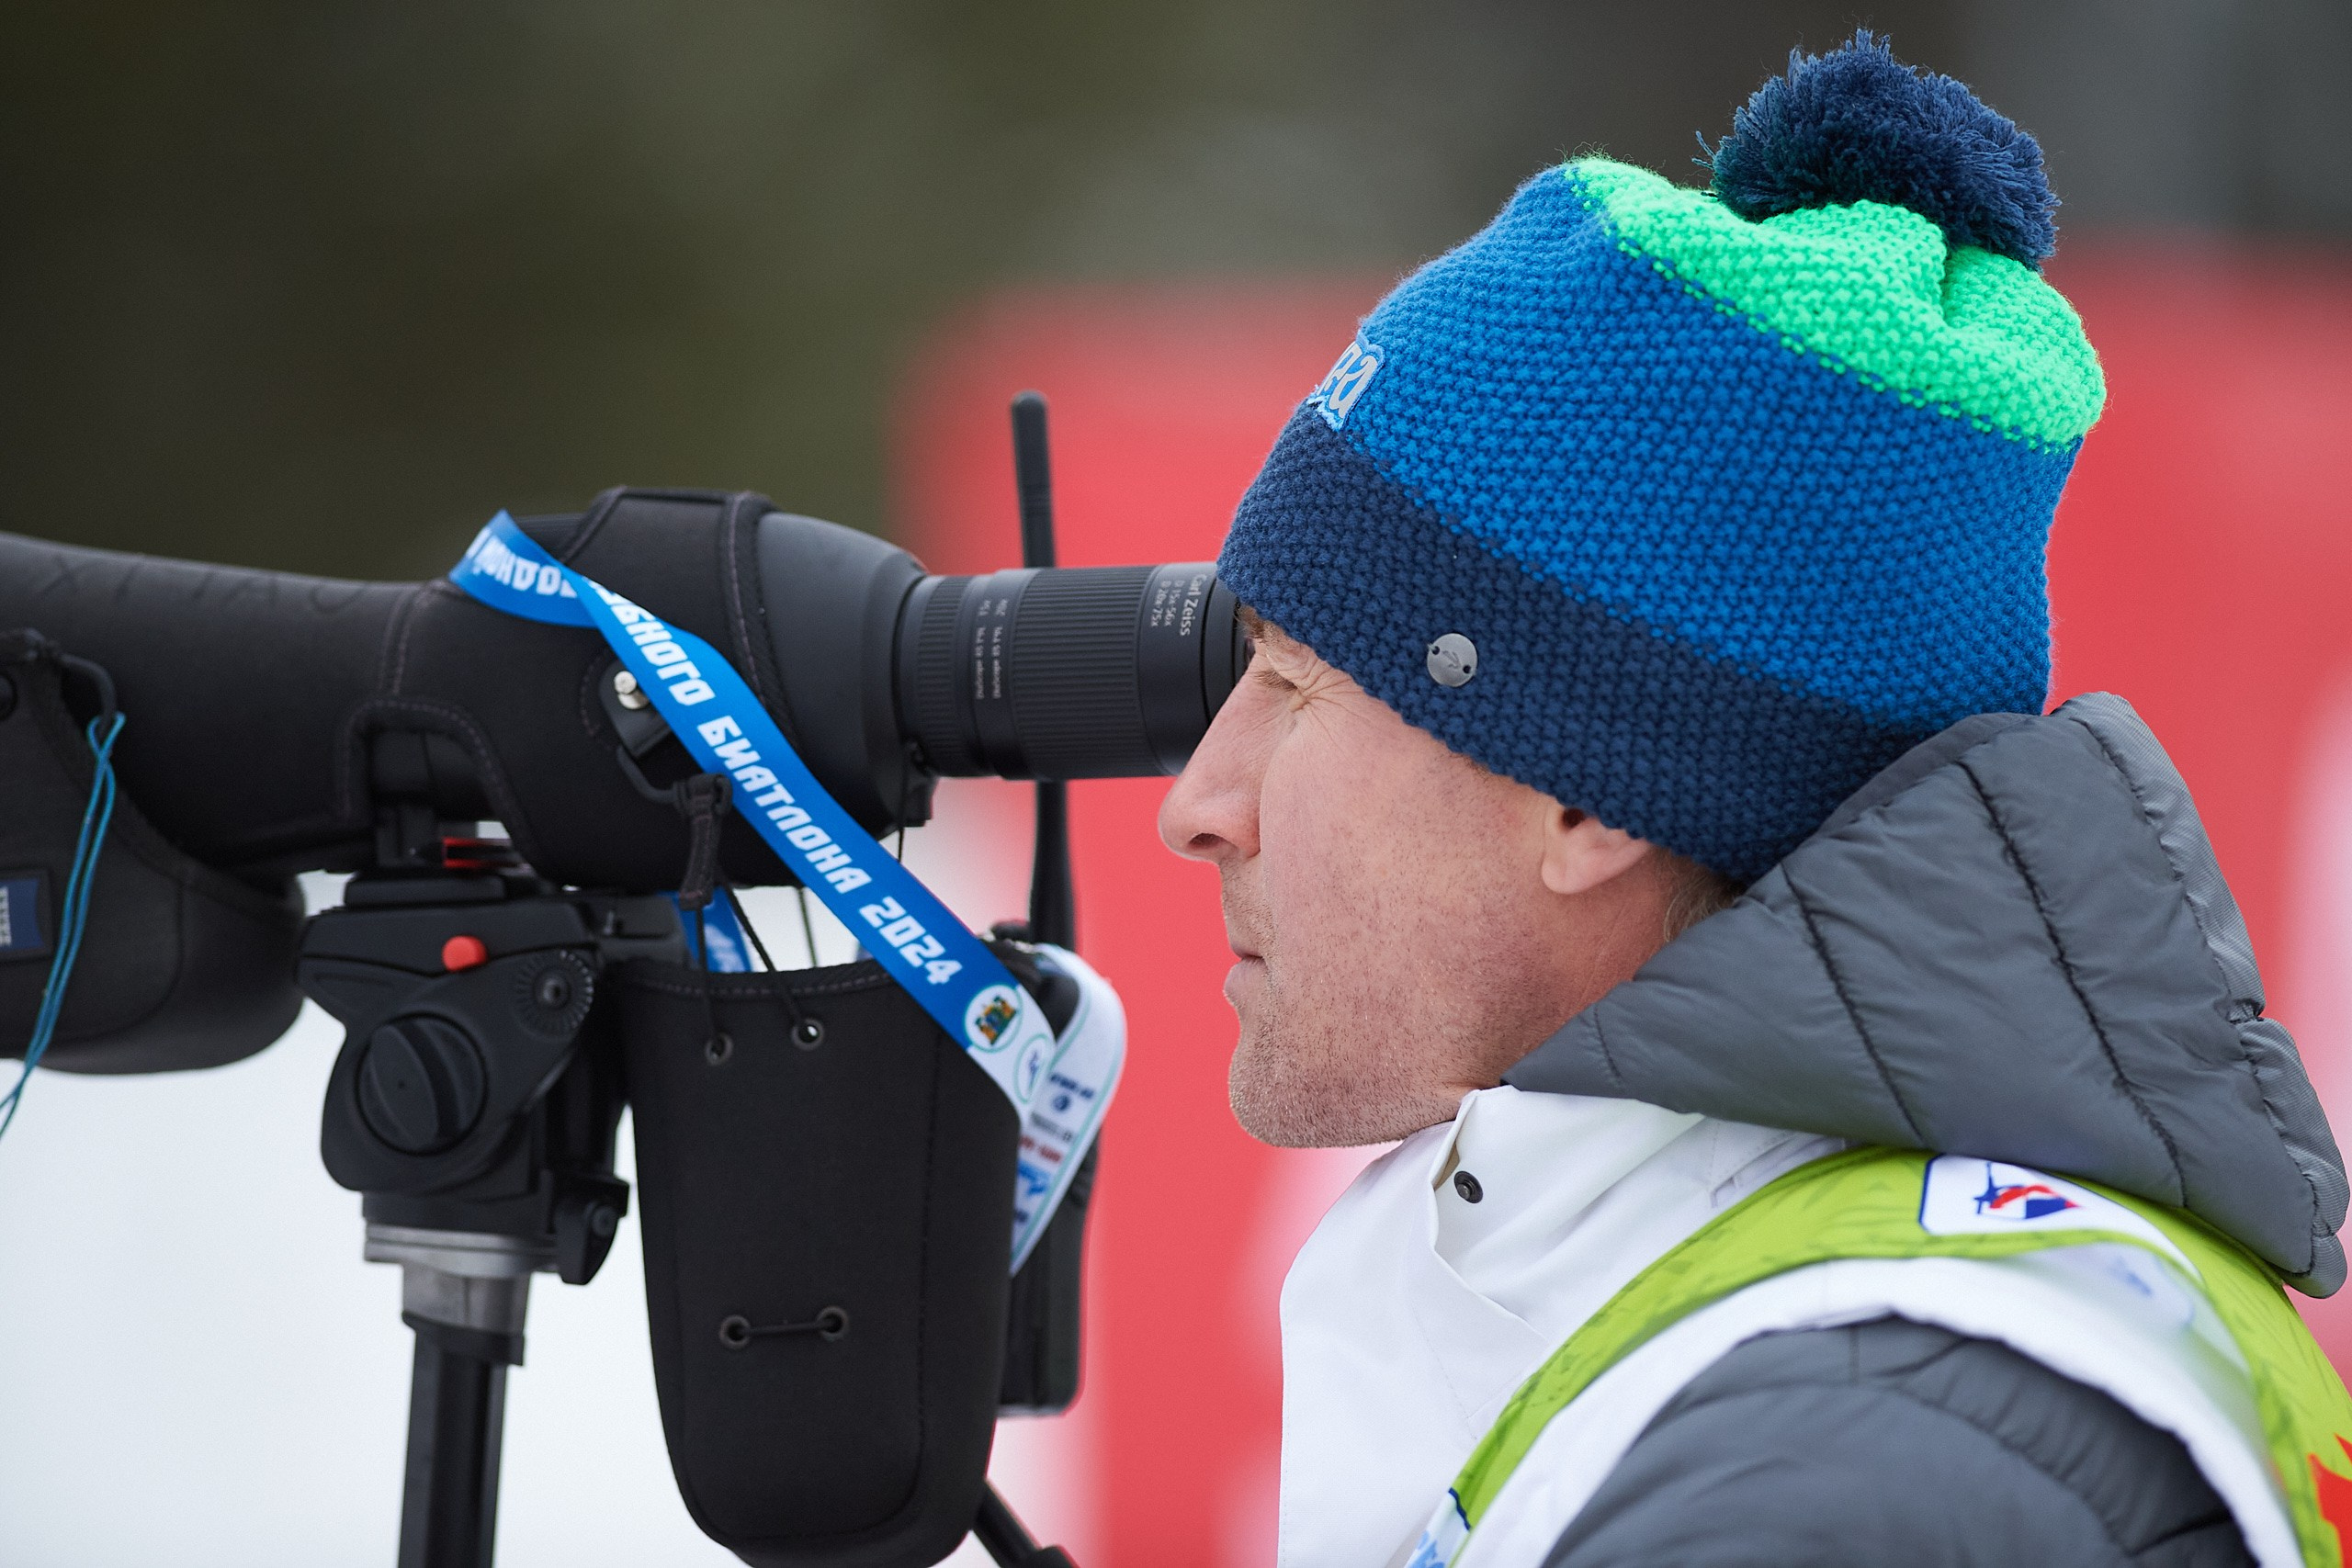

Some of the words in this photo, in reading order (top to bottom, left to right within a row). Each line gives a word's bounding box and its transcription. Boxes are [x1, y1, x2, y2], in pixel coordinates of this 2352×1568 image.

[1187, 573, 1207, 596] Carl
[1179, 598, 1199, 637] Zeiss
[696, 715, 873, 894] БИАТЛОНА
[858, 896, 963, 1004] 2024
